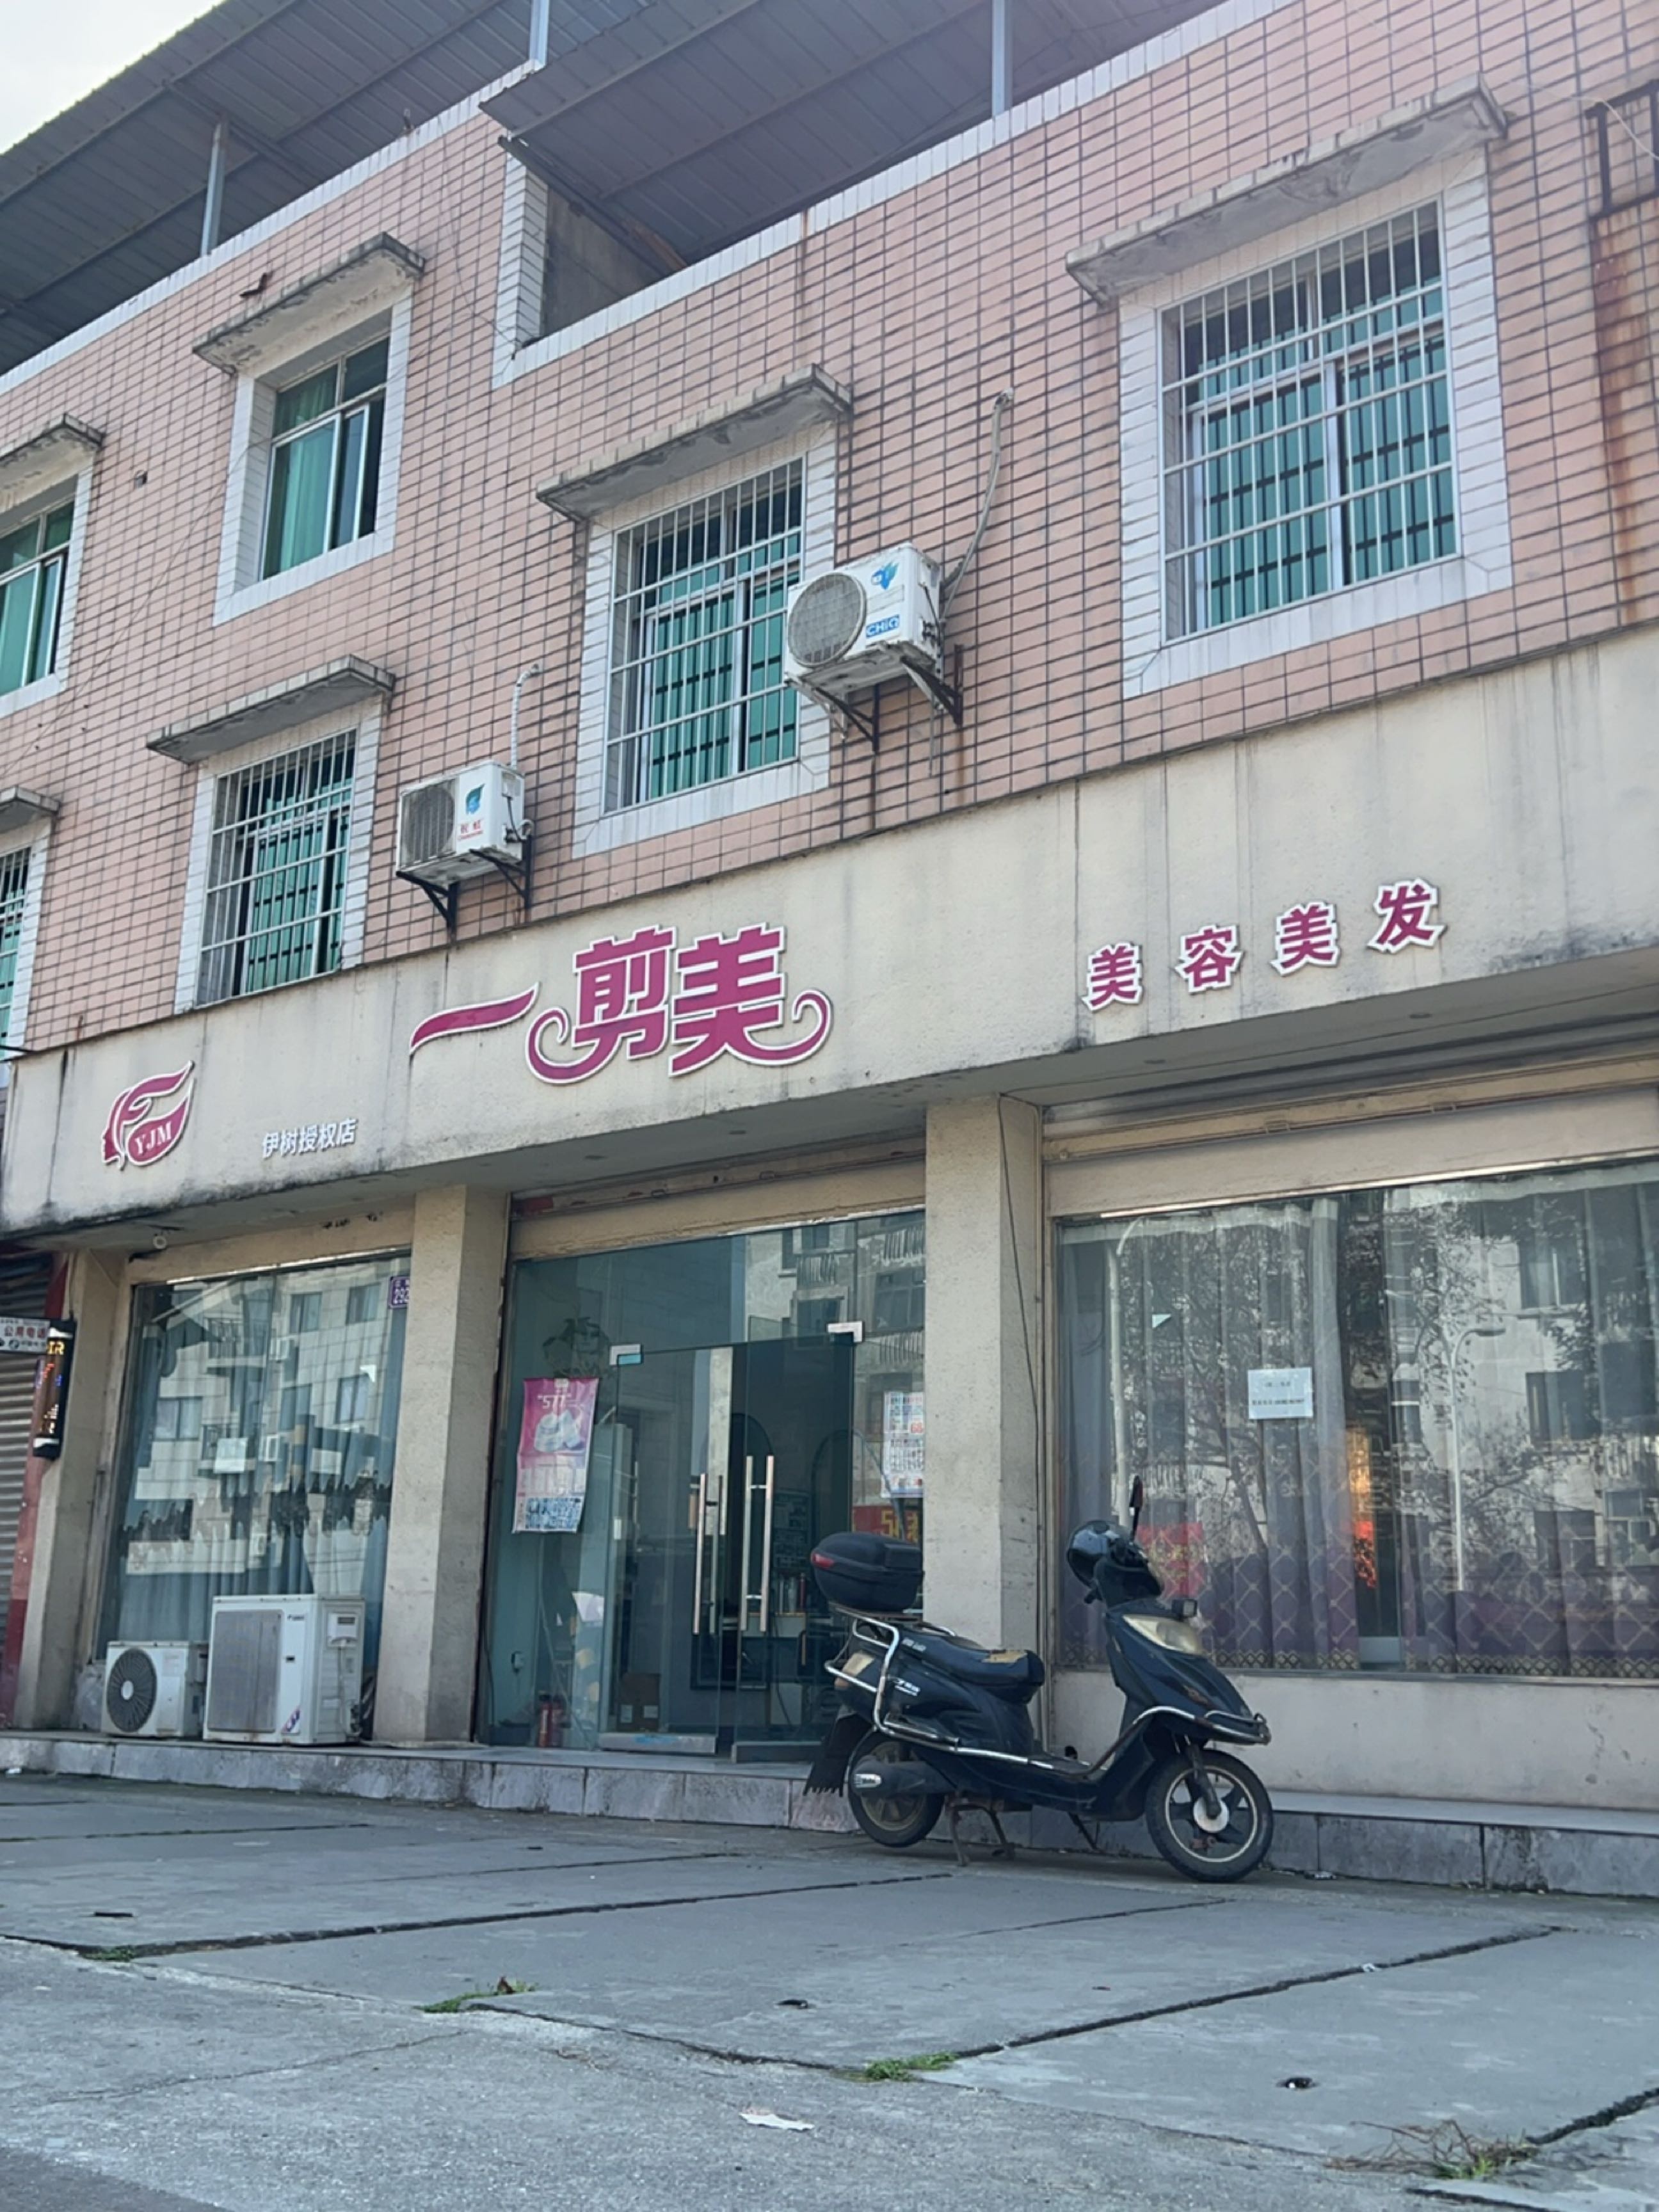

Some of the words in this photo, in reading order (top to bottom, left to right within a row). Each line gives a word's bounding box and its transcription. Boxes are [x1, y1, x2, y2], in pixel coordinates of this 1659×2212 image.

[1083, 879, 1445, 1011] 美容美发
[410, 923, 834, 1085] 一剪美
[134, 1121, 172, 1155] YJM
[262, 1118, 357, 1159] 伊树授权店
